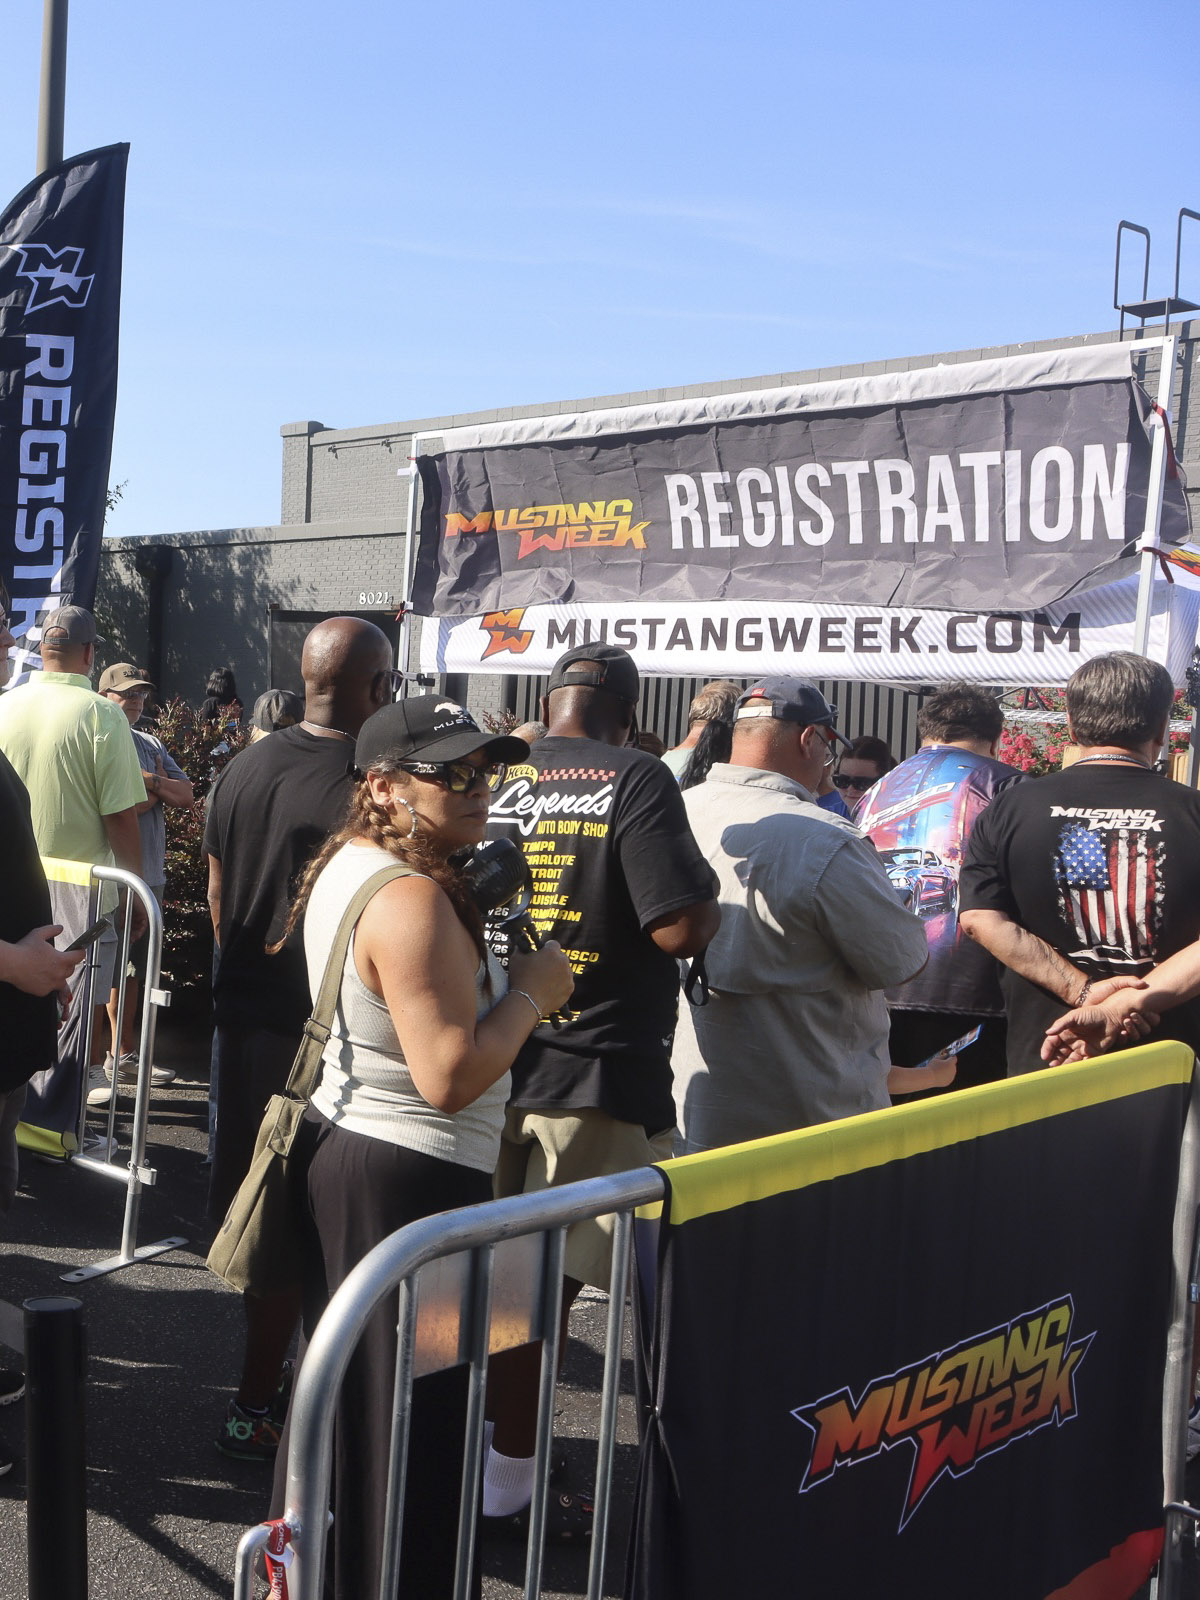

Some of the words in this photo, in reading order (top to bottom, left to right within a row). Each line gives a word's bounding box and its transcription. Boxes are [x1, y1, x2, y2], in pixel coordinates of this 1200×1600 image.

[664, 442, 1132, 549] REGISTRATION
[444, 499, 634, 537] MUSTANG
[518, 516, 652, 560] WEEK
[359, 591, 390, 605] 8021
[546, 612, 1081, 653] MUSTANGWEEK.COM
[487, 779, 613, 836] Legends
[1050, 806, 1157, 819] MUSTANG
[1087, 817, 1166, 832] WEEK
[536, 821, 556, 834] AUTO
[558, 821, 581, 834] BODY
[583, 822, 609, 838] SHOP
[809, 1304, 1071, 1477] MUSTANG
[909, 1341, 1083, 1508] WEEK
